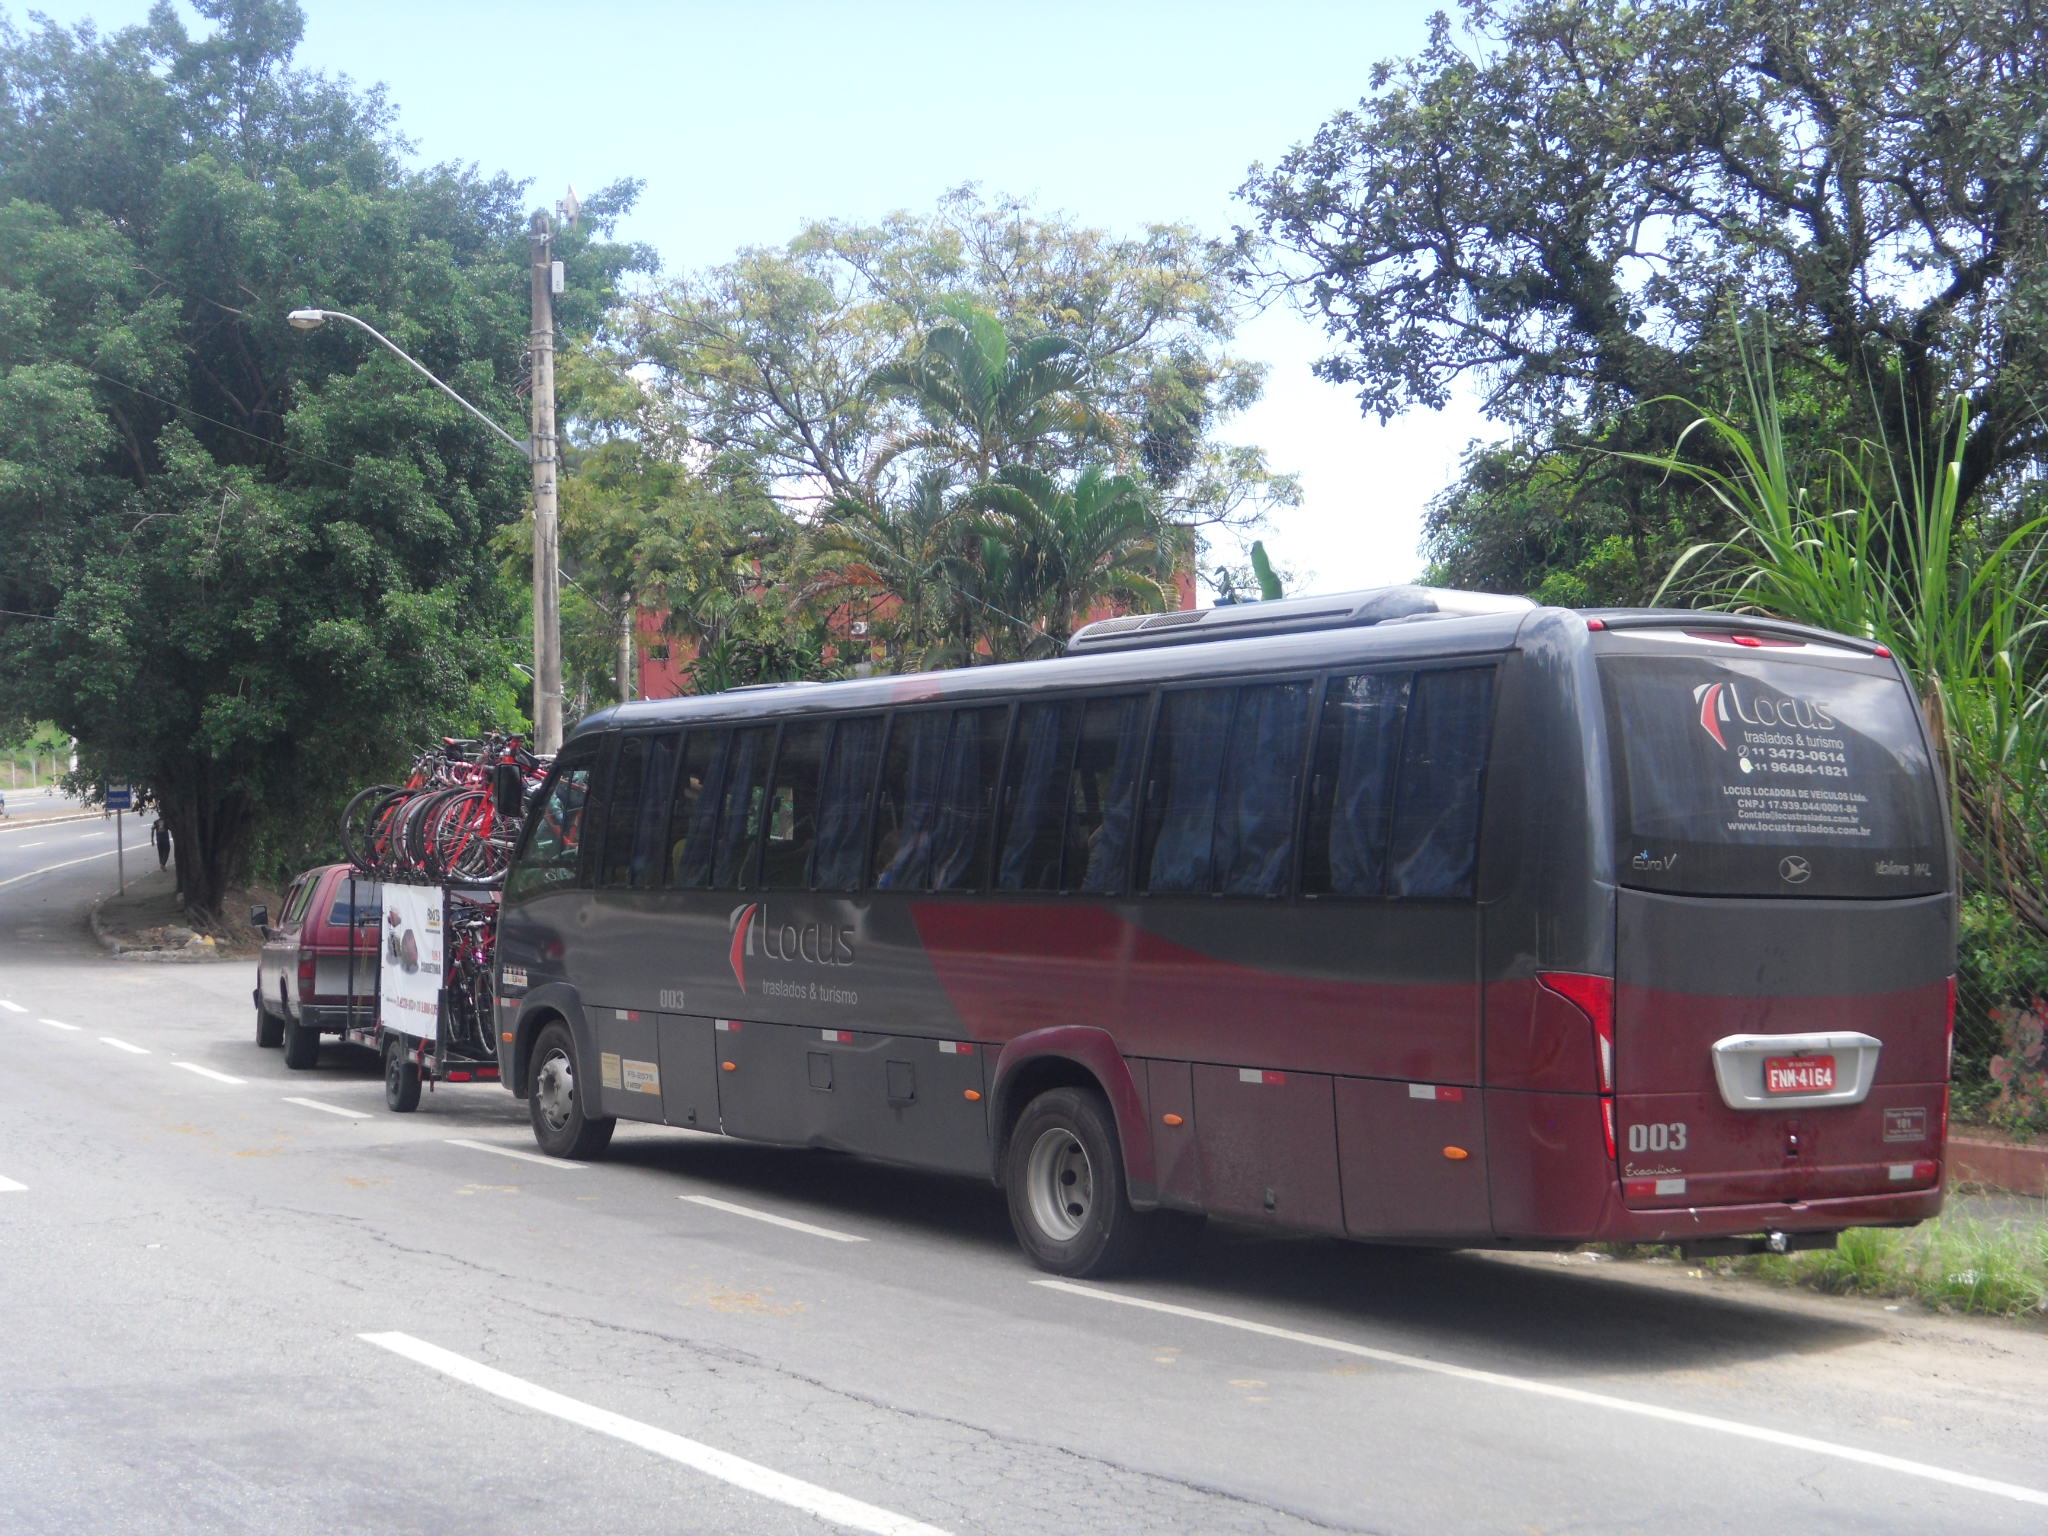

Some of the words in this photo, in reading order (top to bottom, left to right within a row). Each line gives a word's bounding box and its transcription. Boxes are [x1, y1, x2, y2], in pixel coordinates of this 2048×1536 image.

[1729, 683, 1835, 730] Locus
[1744, 730, 1793, 745] traslados
[1796, 734, 1804, 745] &
[1806, 735, 1844, 750] turismo
[1769, 748, 1845, 763] 3473-0614
[1755, 763, 1767, 771] 11
[1771, 762, 1848, 777] 96484-1821
[1723, 786, 1751, 795] LOCUS
[1753, 787, 1797, 798] LOCADORA
[1798, 790, 1809, 798] DE
[1737, 799, 1765, 809] CNPJ
[1727, 822, 1871, 836] www.locustraslados.com.br
[763, 903, 855, 967] Locus
[660, 989, 684, 1009] 003
[762, 980, 806, 998] traslados
[809, 982, 816, 999] &
[820, 986, 857, 1004] turismo
[1629, 1122, 1687, 1152] 003
